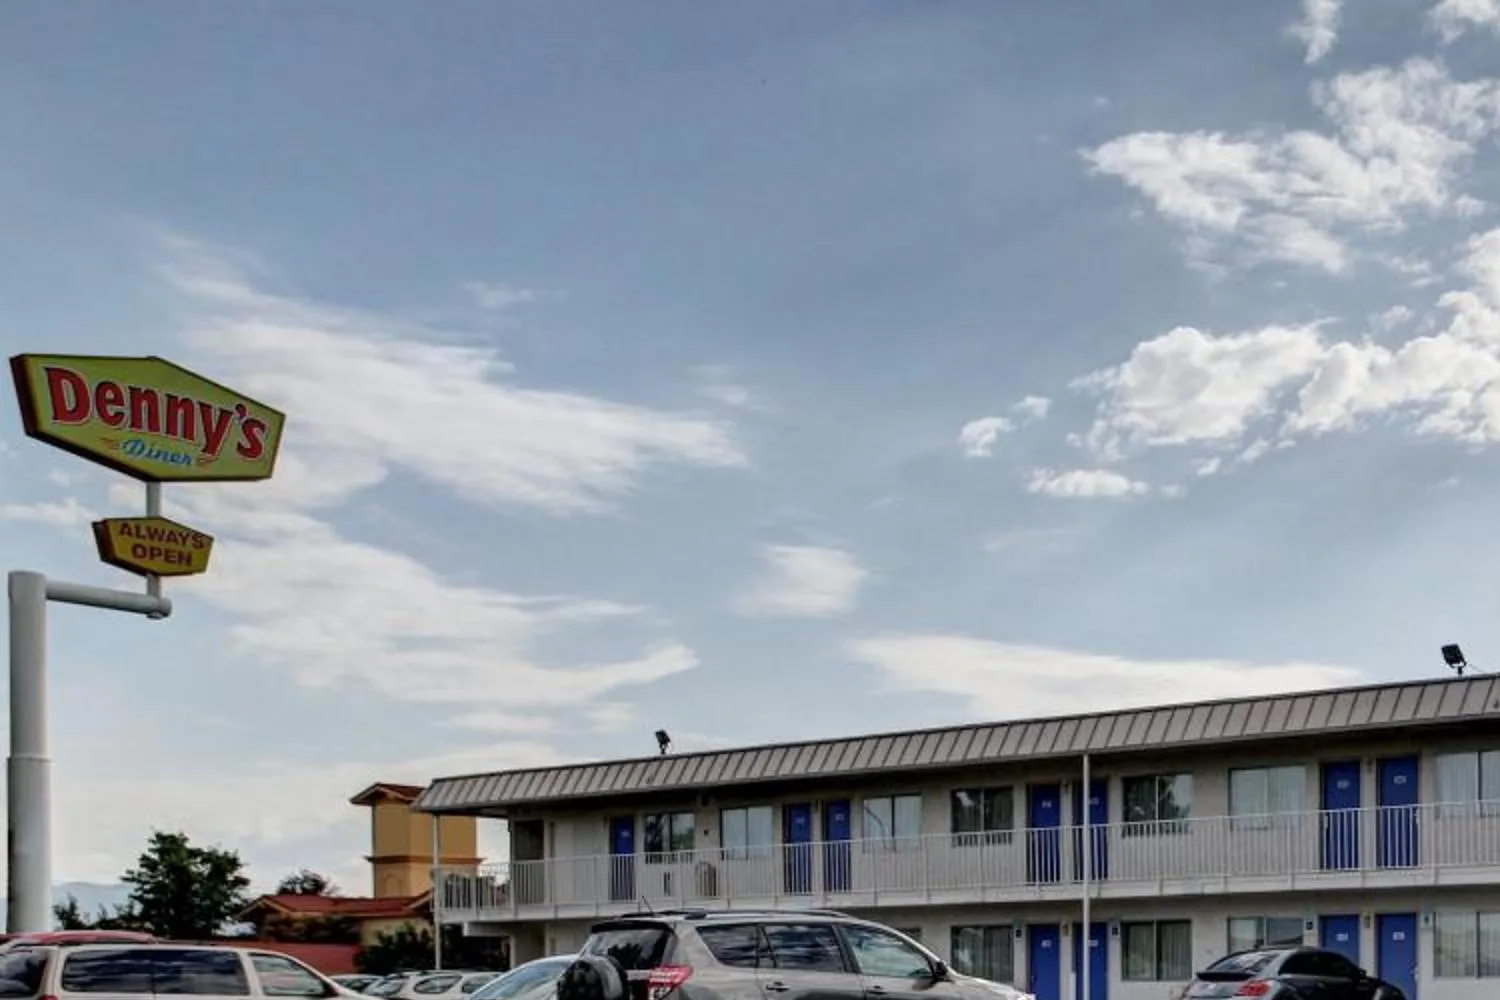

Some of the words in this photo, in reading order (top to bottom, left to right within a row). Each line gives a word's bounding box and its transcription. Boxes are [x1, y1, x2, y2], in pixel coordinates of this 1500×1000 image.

[44, 367, 267, 460] Denny's
[121, 438, 193, 465] Diner
[119, 522, 205, 549] ALWAYS
[131, 543, 193, 566] OPEN
